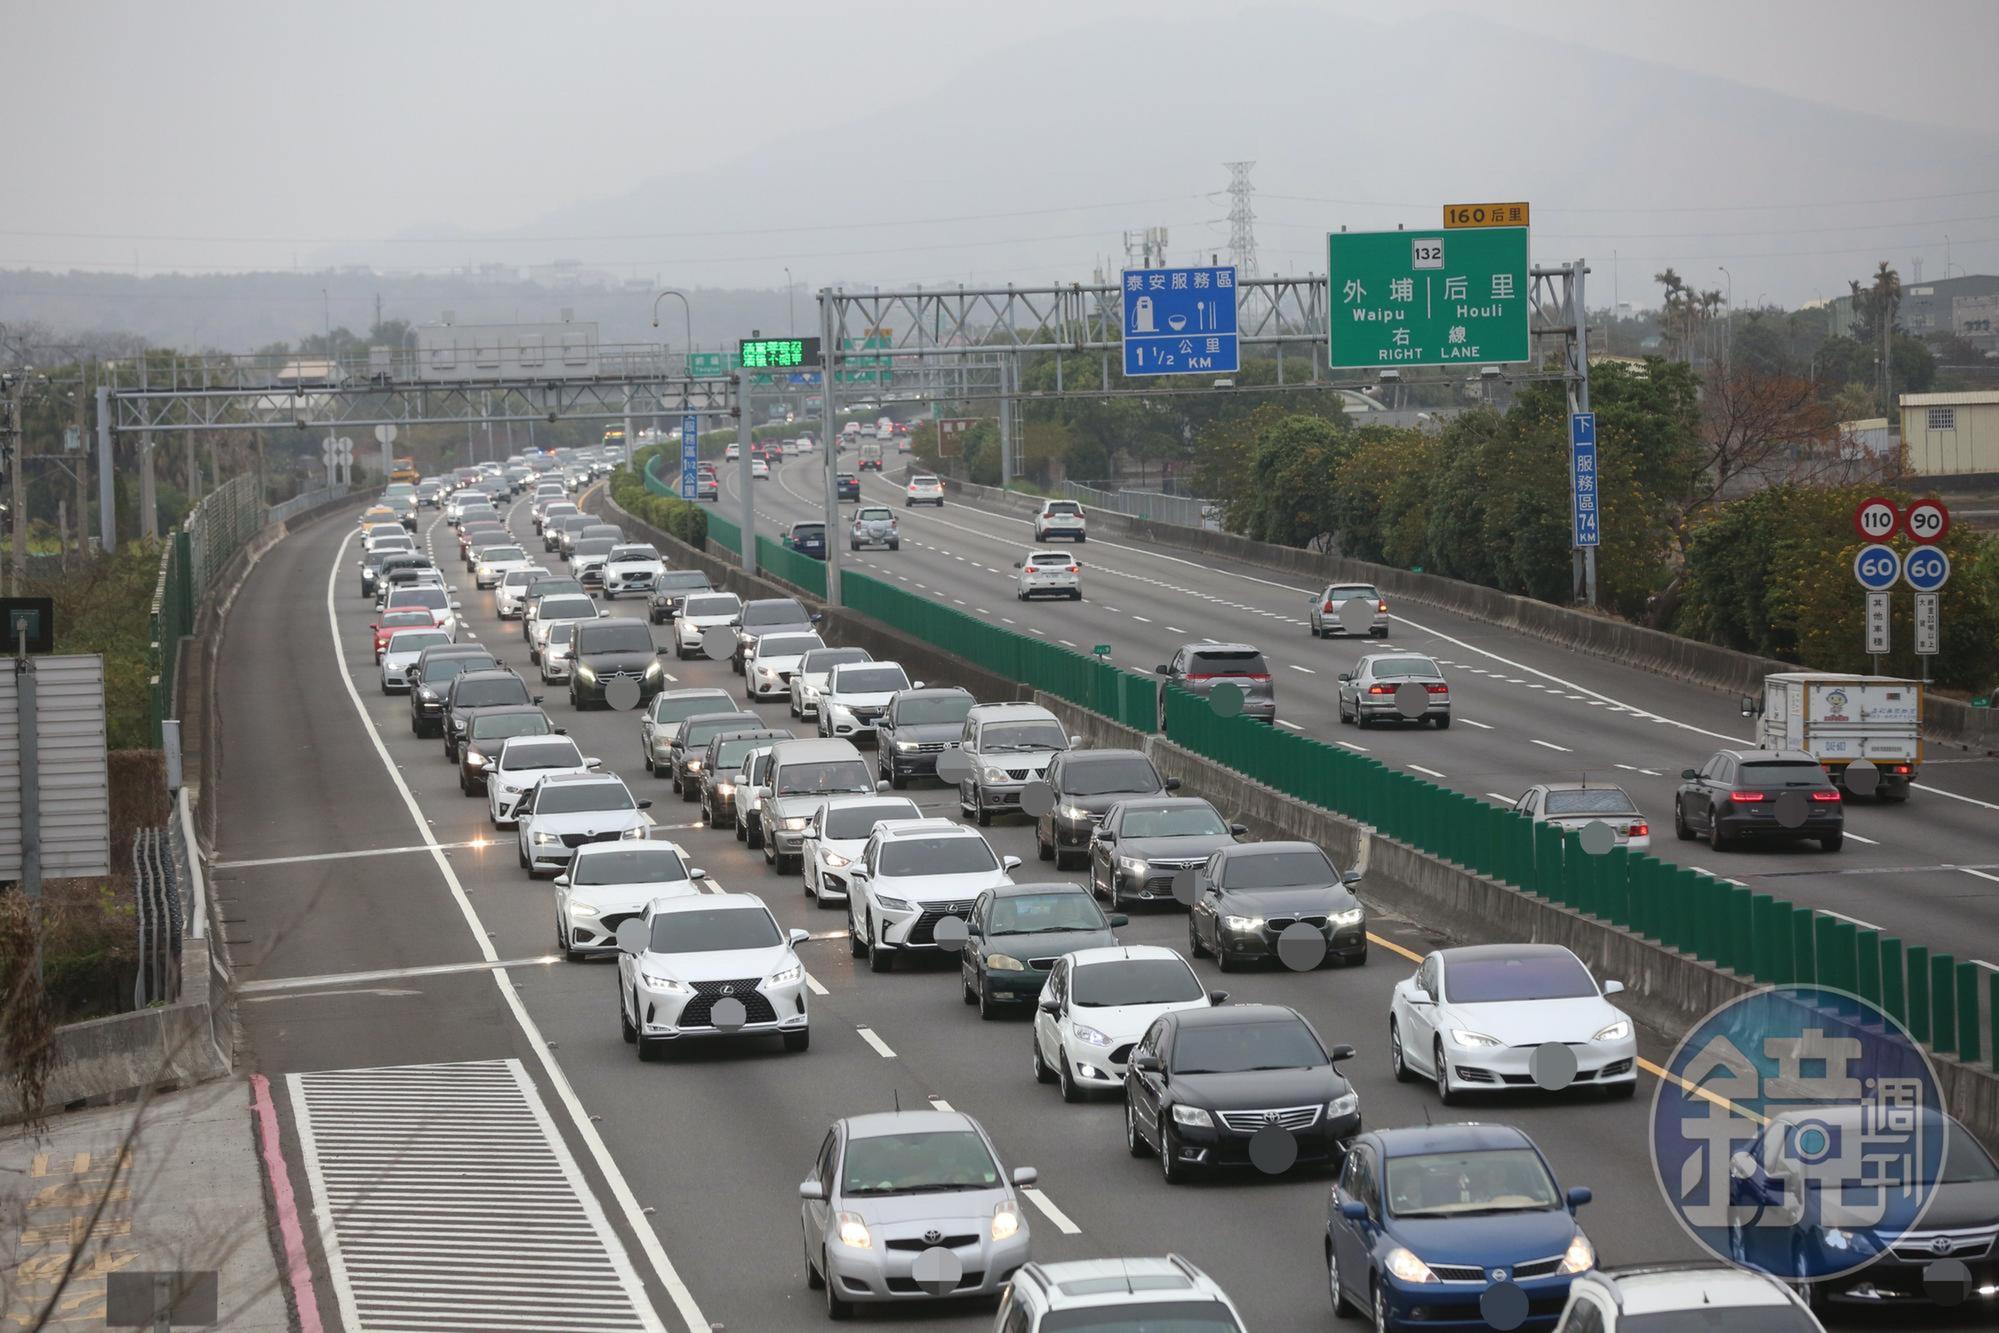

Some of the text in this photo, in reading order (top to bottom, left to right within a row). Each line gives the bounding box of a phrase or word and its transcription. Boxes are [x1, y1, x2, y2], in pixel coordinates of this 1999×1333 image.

[1450, 207, 1522, 224] 160 后里
[1415, 247, 1441, 260] 132
[1127, 270, 1233, 291] 泰安服務區
[1443, 273, 1515, 300] 后里
[1343, 277, 1414, 304] 外埔
[1352, 308, 1405, 323] Waipu
[1456, 304, 1502, 318] Houli
[1178, 337, 1220, 354] 公里
[1378, 346, 1480, 360] RIGHT LANE
[1188, 356, 1212, 369] KM
[1575, 416, 1595, 511] 下一服務區
[1579, 513, 1596, 530] 74
[1864, 512, 1891, 528] 110
[1913, 513, 1940, 530] 90
[1579, 532, 1596, 542] KM
[1861, 558, 1893, 577] 60
[1911, 559, 1943, 578] 60
[1873, 599, 1883, 646] 其他車種
